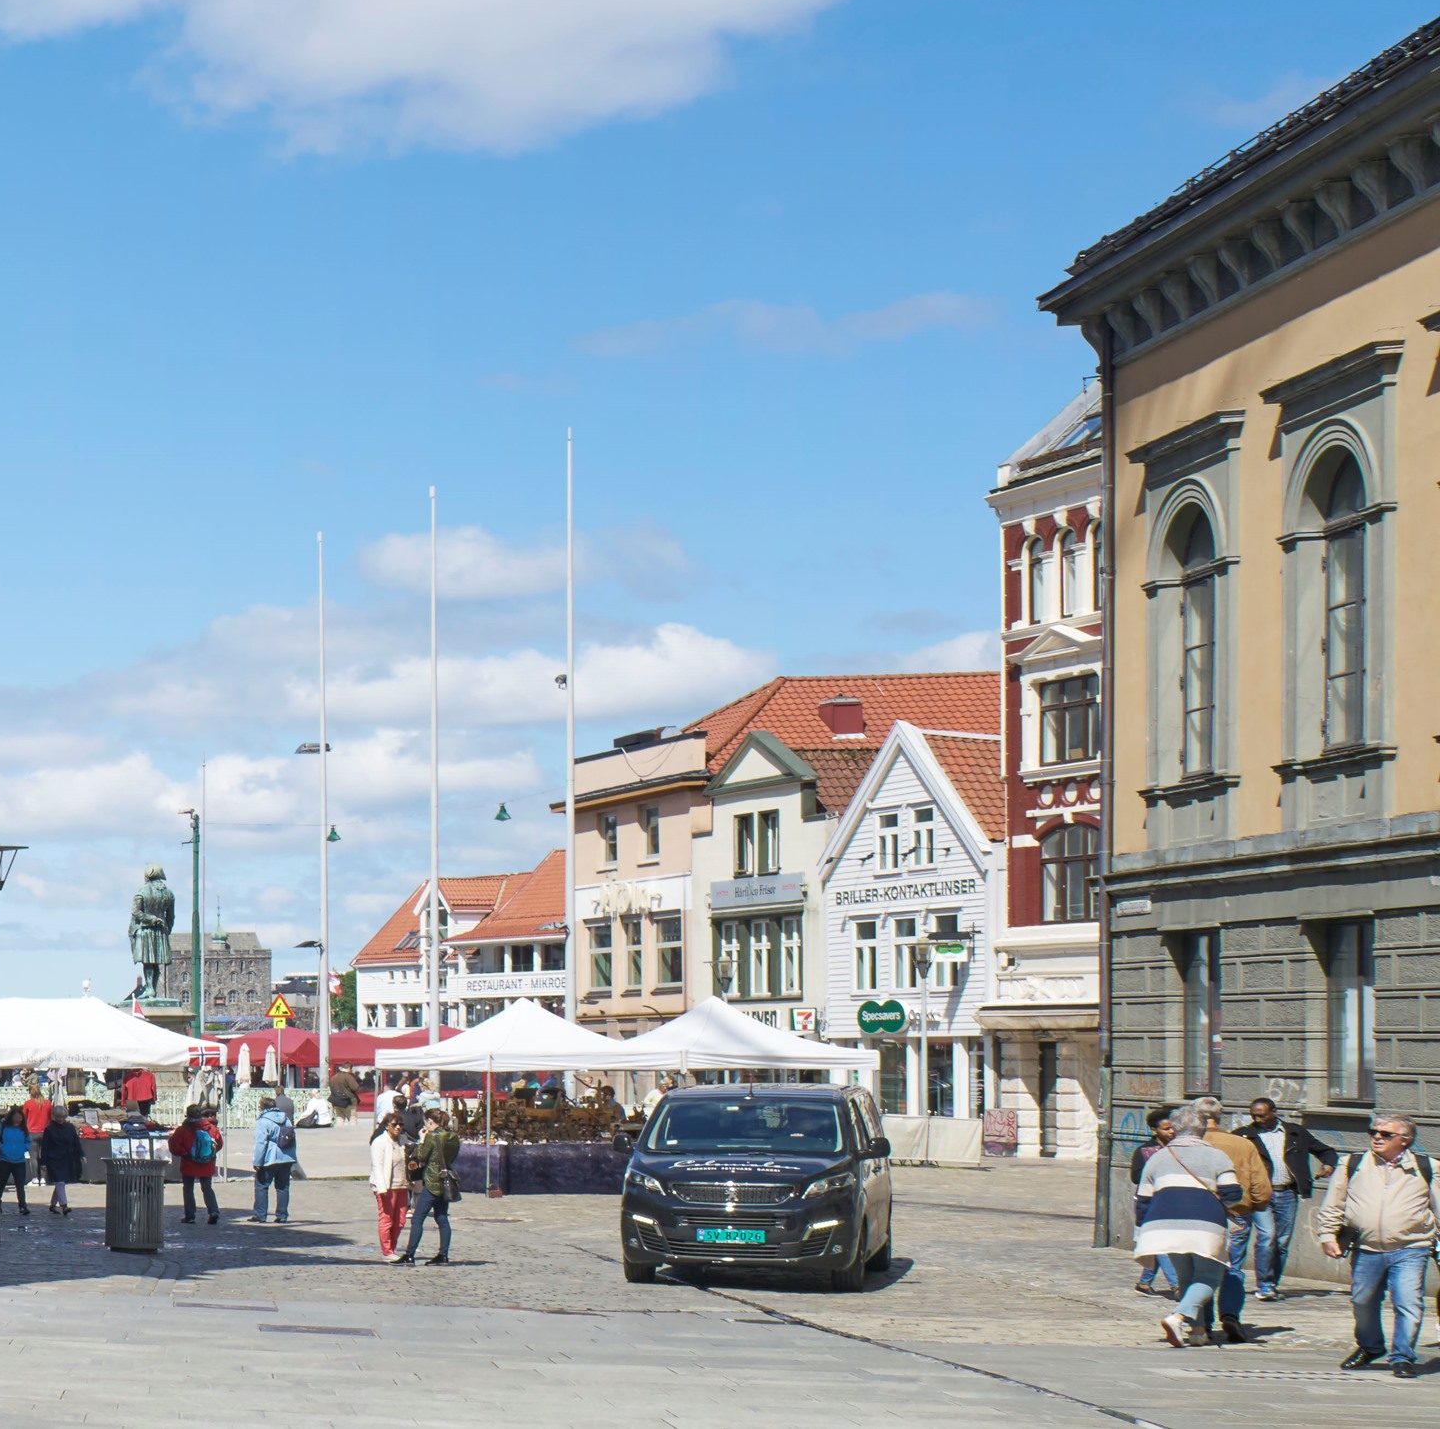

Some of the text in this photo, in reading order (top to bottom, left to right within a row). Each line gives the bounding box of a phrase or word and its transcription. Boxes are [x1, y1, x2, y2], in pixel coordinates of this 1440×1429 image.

[835, 878, 977, 905] BRILLER-KONTAKTLINSER
[466, 979, 523, 992] RESTAURANT
[861, 1010, 902, 1023] Specsavers
[706, 1231, 761, 1241] SV 82026
